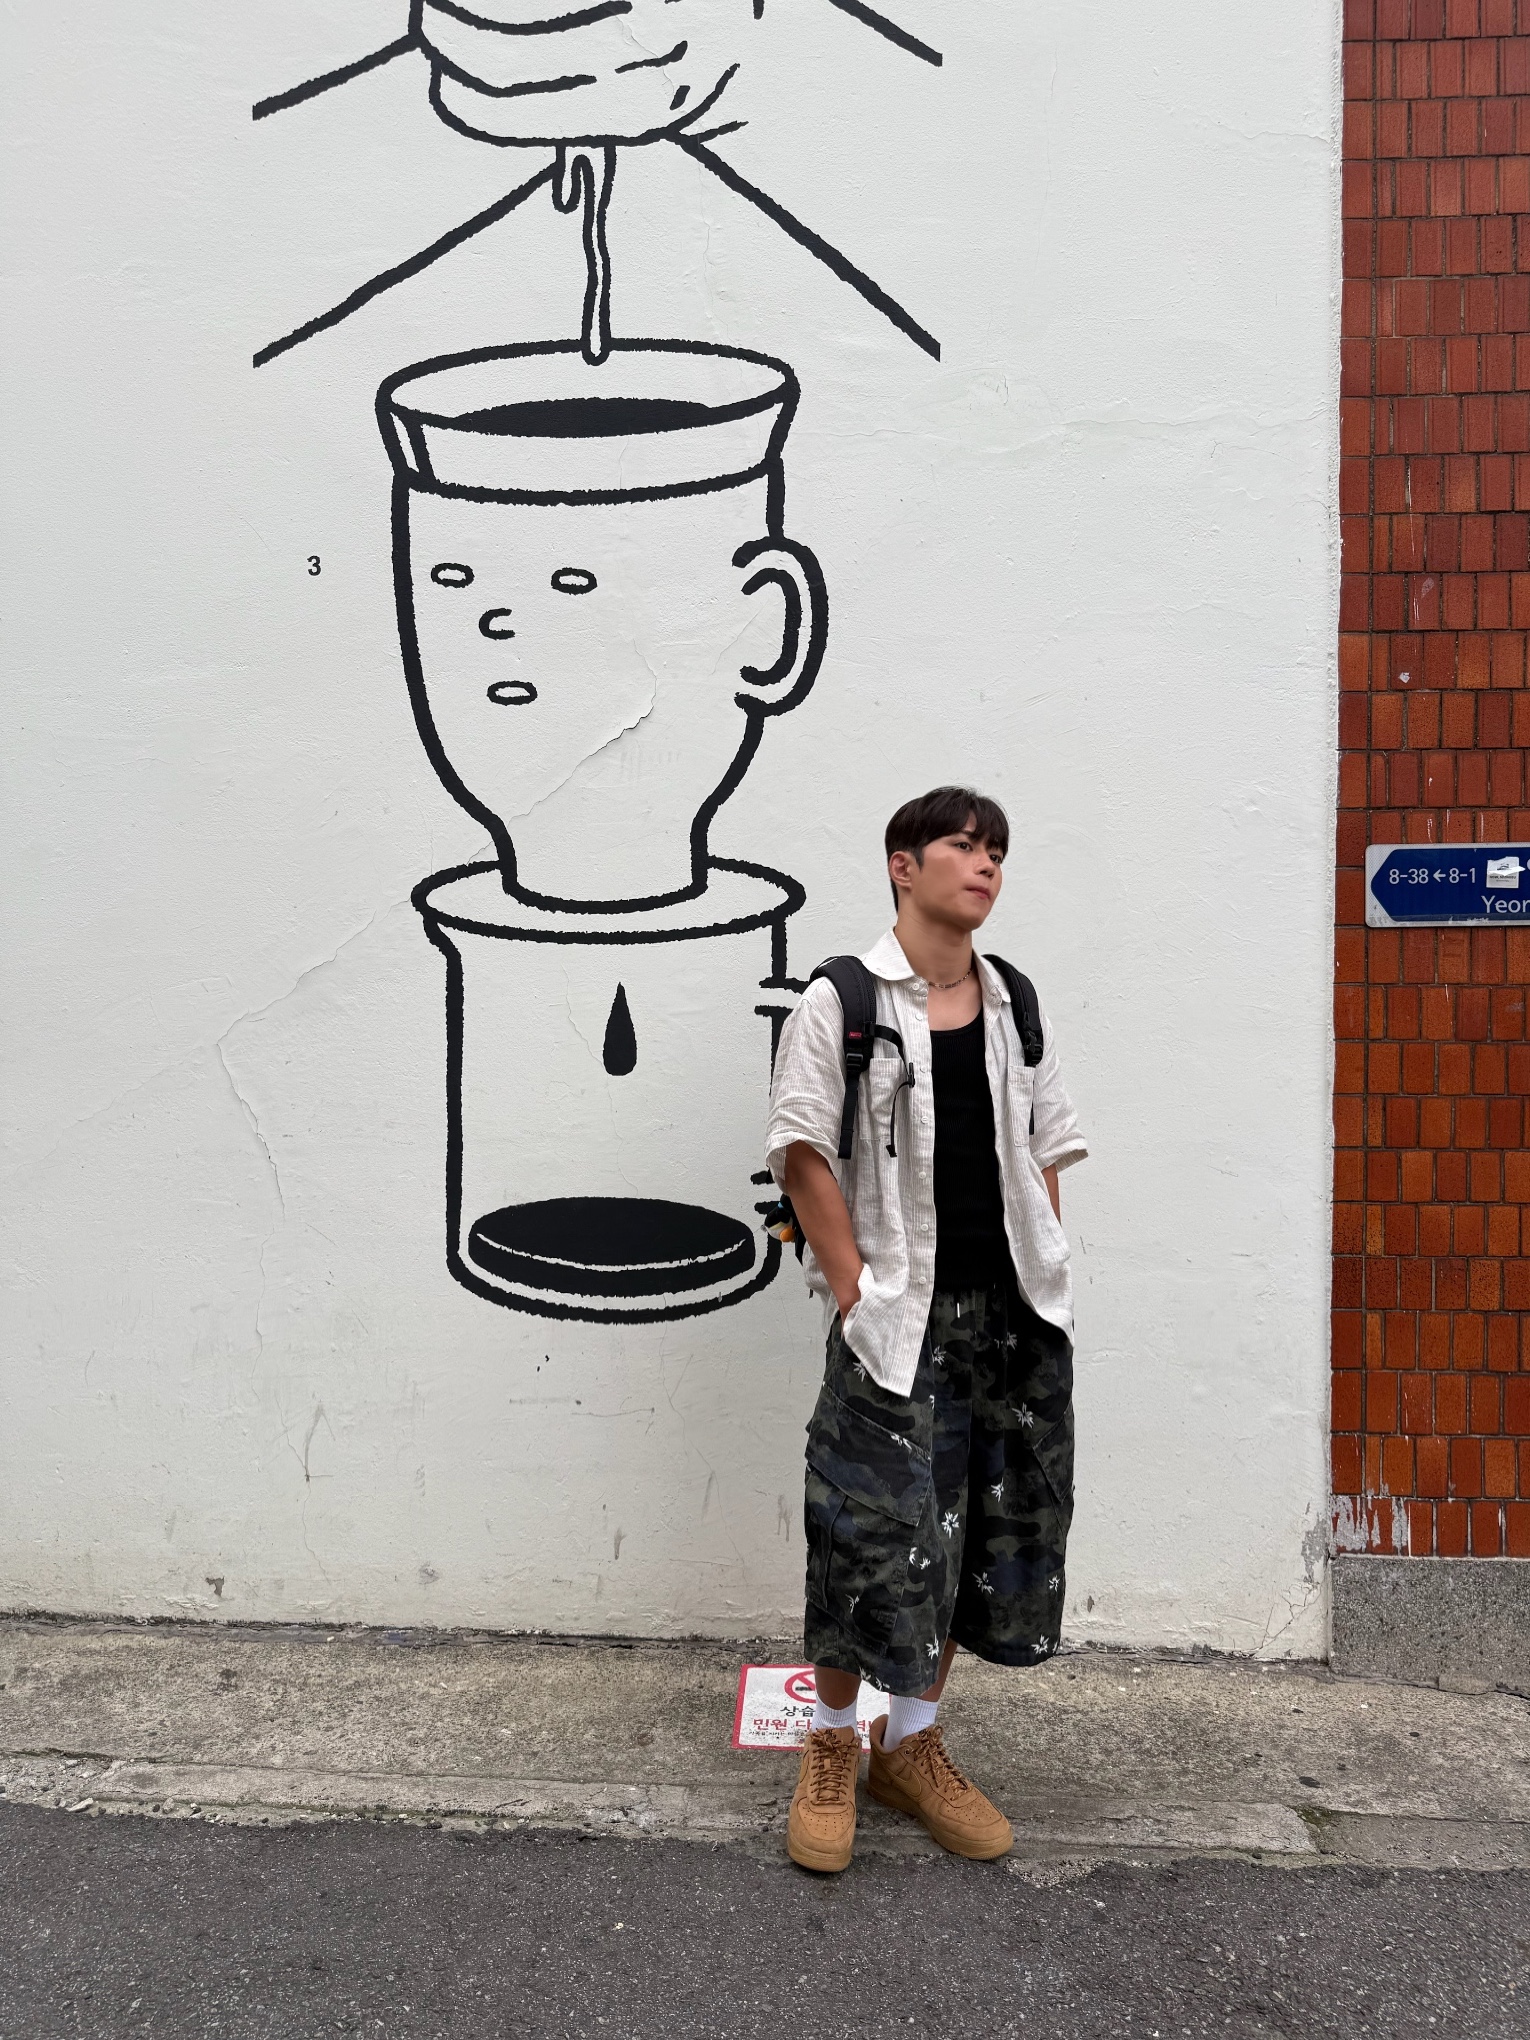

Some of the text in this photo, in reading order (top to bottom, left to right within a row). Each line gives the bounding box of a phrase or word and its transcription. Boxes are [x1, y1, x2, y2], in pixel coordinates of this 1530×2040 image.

[307, 555, 322, 576] 3
[1389, 867, 1476, 885] 8-38 8-1
[753, 1718, 788, 1731] 민원
